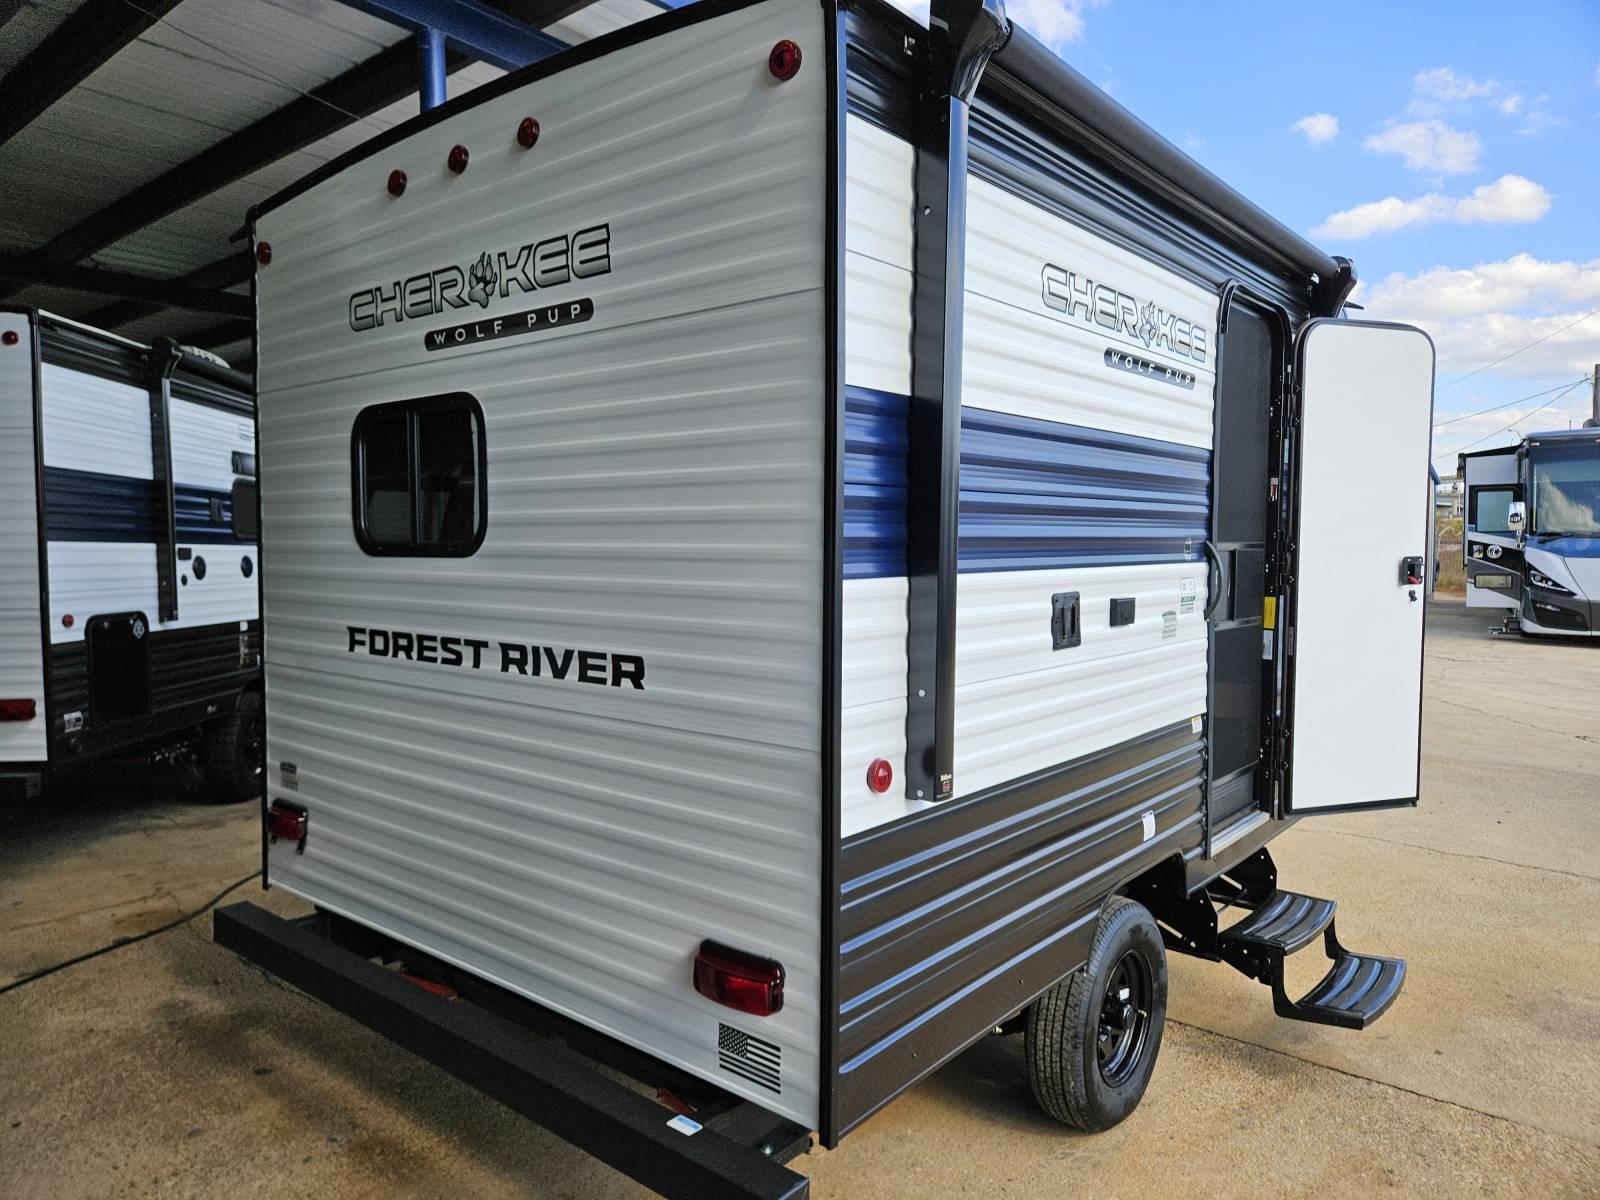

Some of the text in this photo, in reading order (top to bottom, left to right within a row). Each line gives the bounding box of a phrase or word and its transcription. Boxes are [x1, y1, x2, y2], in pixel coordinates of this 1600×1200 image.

[433, 303, 581, 345] WOLF PUP
[1111, 350, 1191, 386] WOLF PUP
[346, 625, 645, 690] FOREST RIVER
